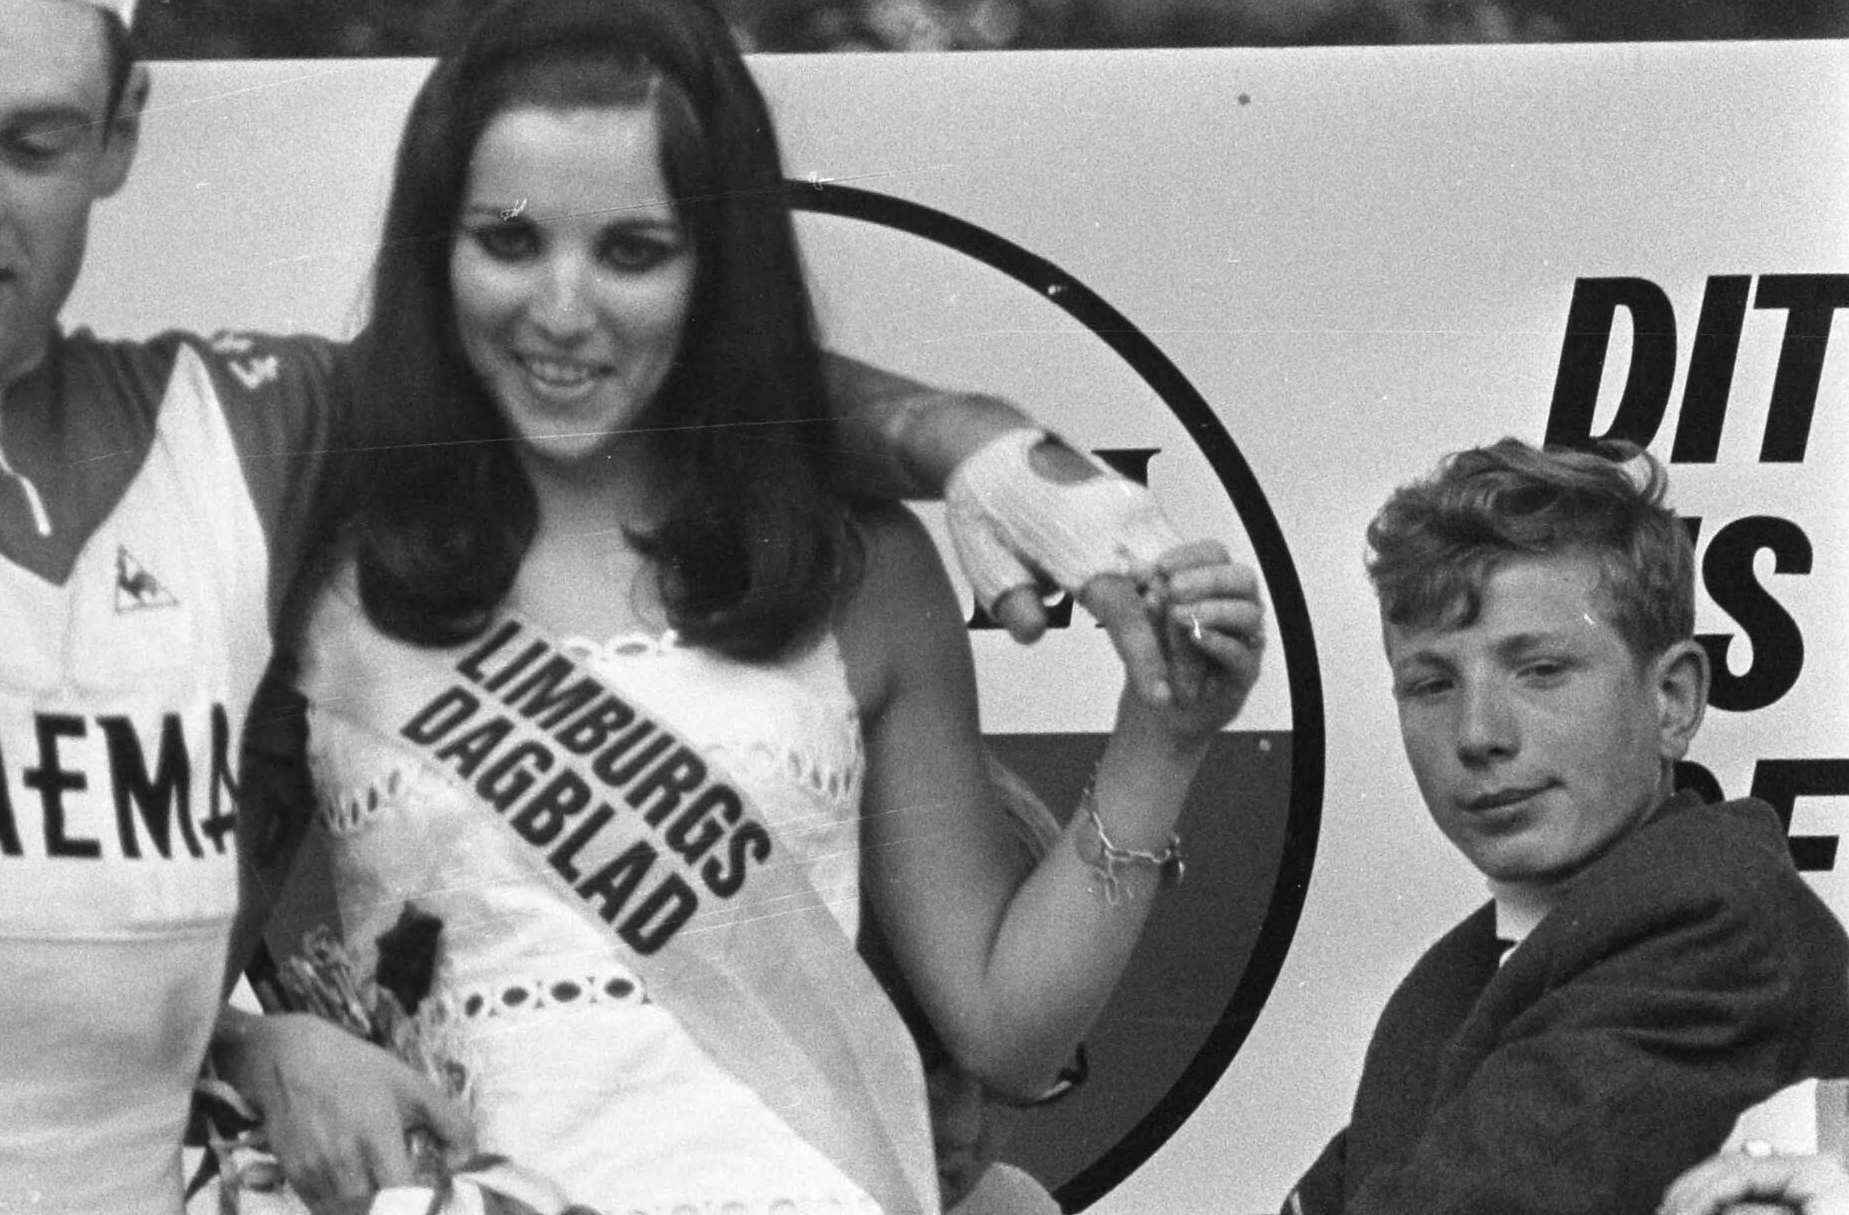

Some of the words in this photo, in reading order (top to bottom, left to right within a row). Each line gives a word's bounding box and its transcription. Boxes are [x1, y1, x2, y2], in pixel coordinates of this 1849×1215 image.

[1542, 273, 1849, 464] DIT
[1688, 515, 1813, 712] S
[400, 685, 699, 956] DAGBLAD
[455, 620, 772, 899] LIMBURGS
